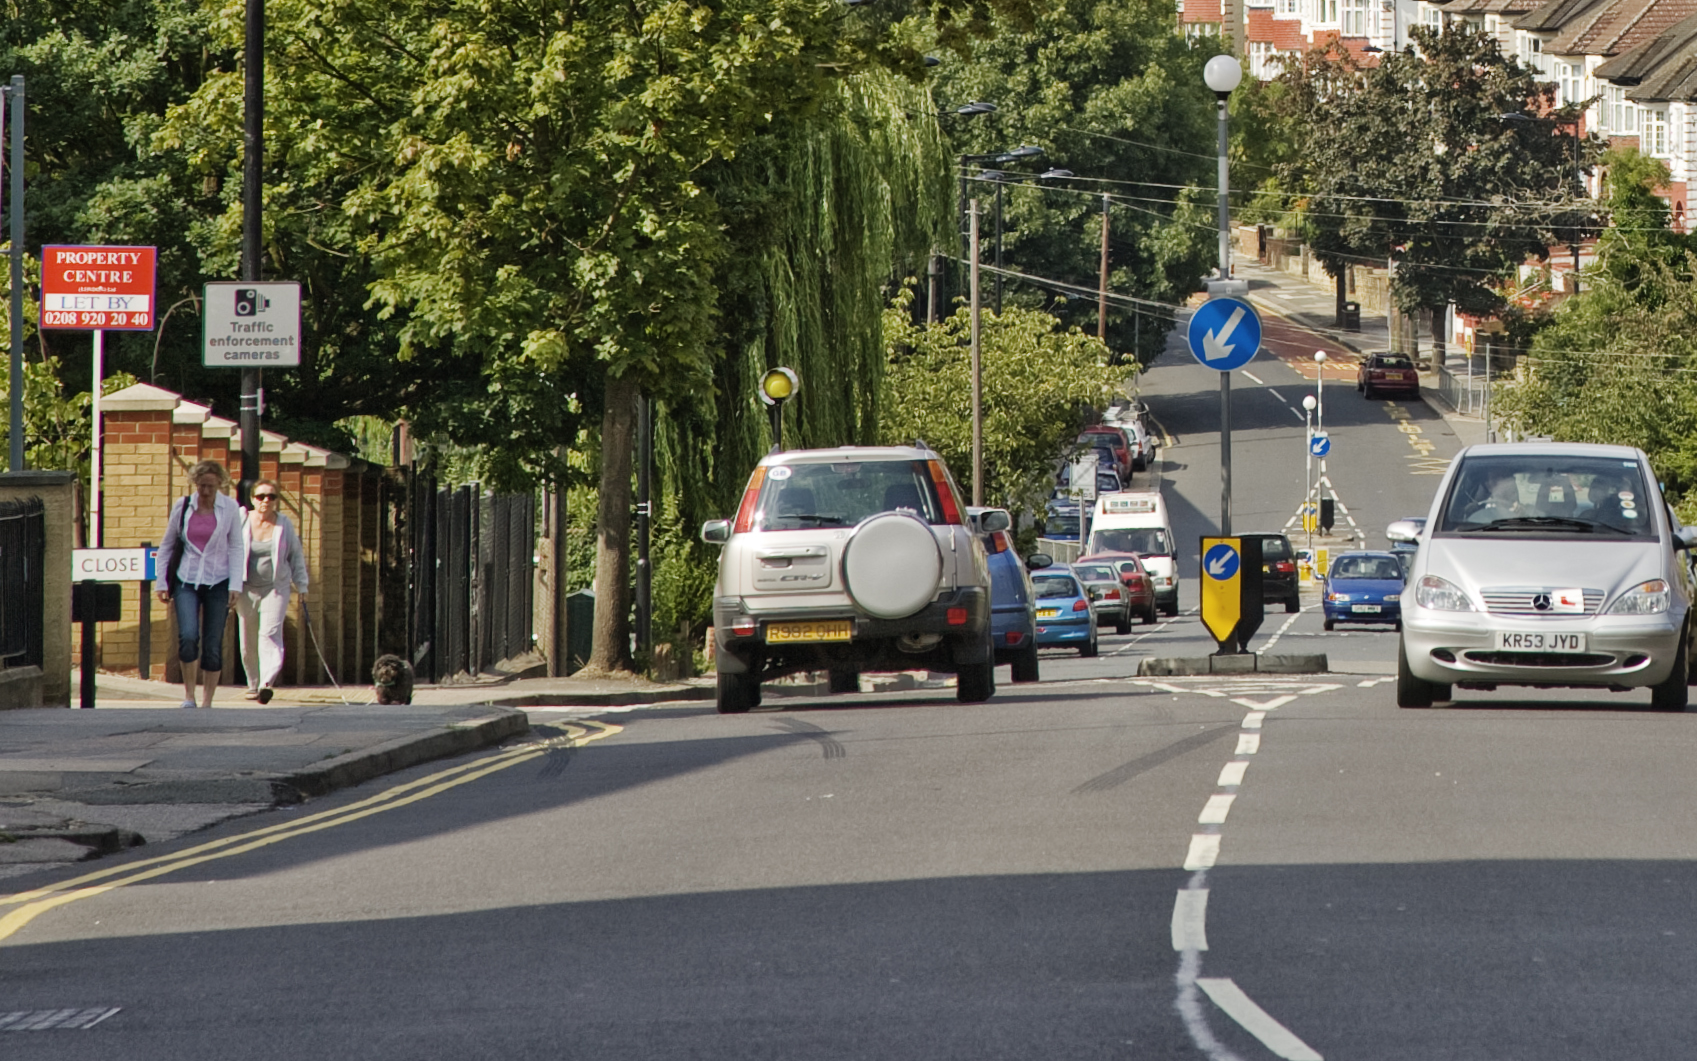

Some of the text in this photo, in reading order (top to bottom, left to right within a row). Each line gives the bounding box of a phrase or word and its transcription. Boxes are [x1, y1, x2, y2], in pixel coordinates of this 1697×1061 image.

[56, 251, 142, 265] PROPERTY
[63, 270, 133, 283] CENTRE
[60, 296, 135, 309] LET BY
[45, 312, 149, 326] 0208 920 20 40
[230, 321, 274, 333] Traffic
[209, 335, 294, 347] enforcement
[223, 351, 280, 360] cameras
[81, 558, 139, 573] CLOSE
[1503, 633, 1579, 649] KR53 JYD
